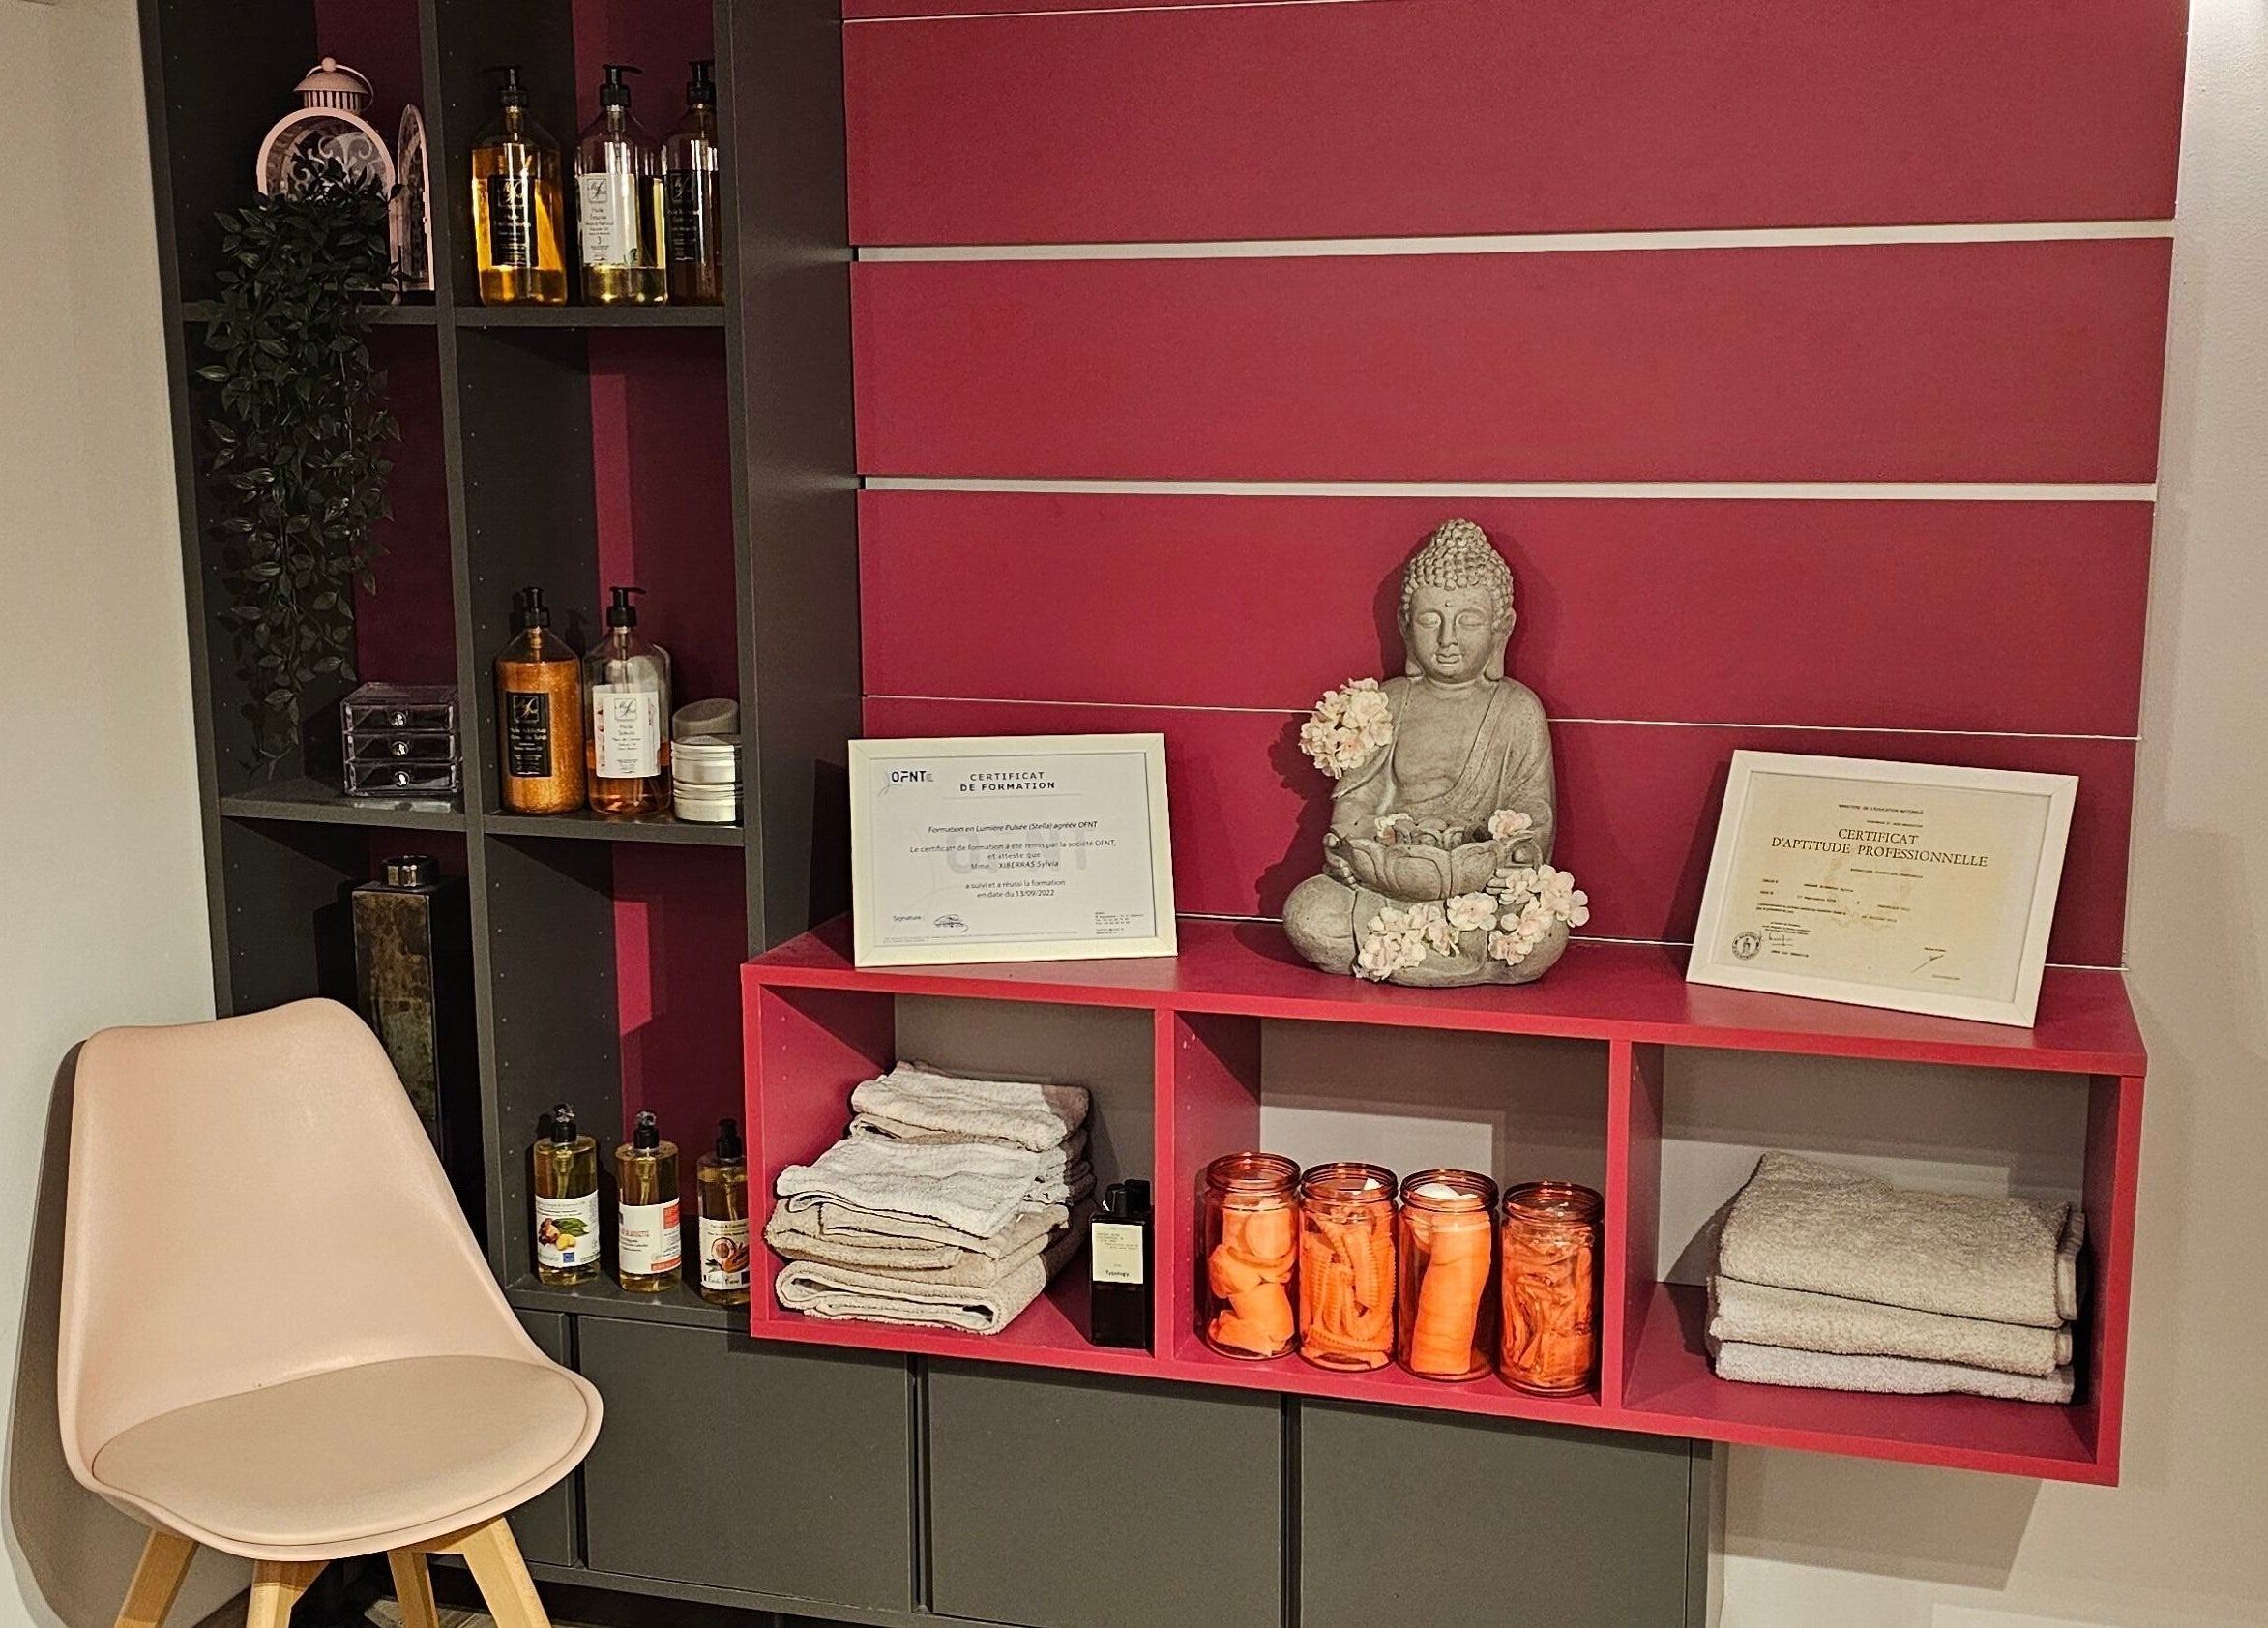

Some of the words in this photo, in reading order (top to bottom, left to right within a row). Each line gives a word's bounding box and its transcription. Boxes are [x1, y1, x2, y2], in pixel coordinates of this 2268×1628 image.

[970, 771, 1045, 782] CERTIFICAT
[960, 784, 976, 792] DE
[982, 782, 1055, 791] FORMATION
[928, 825, 964, 834] Formation
[1838, 828, 1919, 845] CERTIFICAT
[957, 843, 967, 851] de
[967, 843, 1003, 851] formation
[998, 851, 1024, 860] atteste
[1771, 836, 1851, 855] D'APTITUDE
[1857, 844, 1988, 868] PROFESSIONNELLE
[1037, 859, 1059, 869] Sylvia
[1031, 878, 1066, 887] formation
[987, 890, 1003, 899] date
